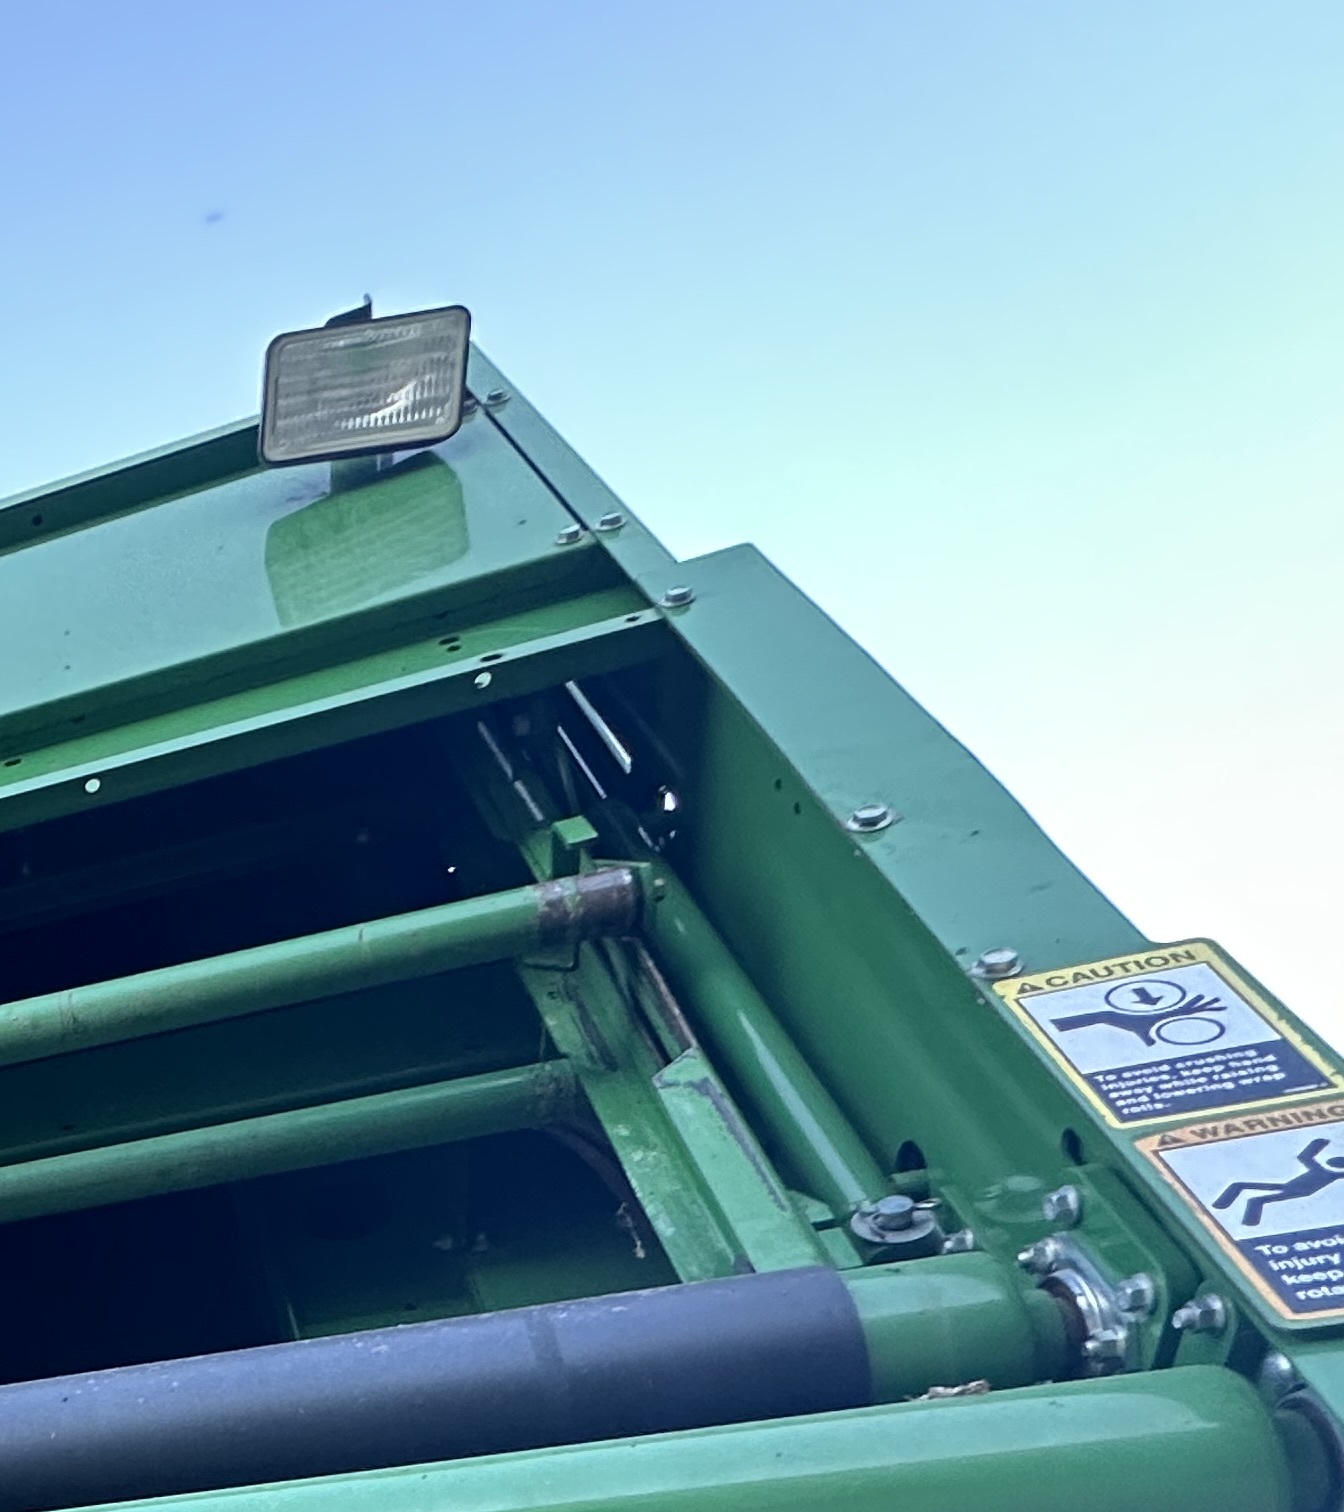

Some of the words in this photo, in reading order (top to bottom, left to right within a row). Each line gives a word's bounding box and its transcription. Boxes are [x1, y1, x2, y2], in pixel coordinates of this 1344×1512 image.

[1045, 950, 1196, 988] CAUTION
[1094, 1074, 1117, 1082] To
[1121, 1064, 1171, 1078] avoid
[1175, 1049, 1258, 1069] crushing
[1179, 1064, 1225, 1078] keep
[1108, 1086, 1153, 1099] away
[1158, 1077, 1208, 1090] while
[1212, 1064, 1280, 1081] raising
[1115, 1095, 1150, 1107] and
[1153, 1081, 1236, 1100] lowering
[1238, 1072, 1287, 1085] wrap
[1254, 1244, 1289, 1256] To
[1268, 1252, 1341, 1271] injury
[1280, 1269, 1344, 1285] keep
